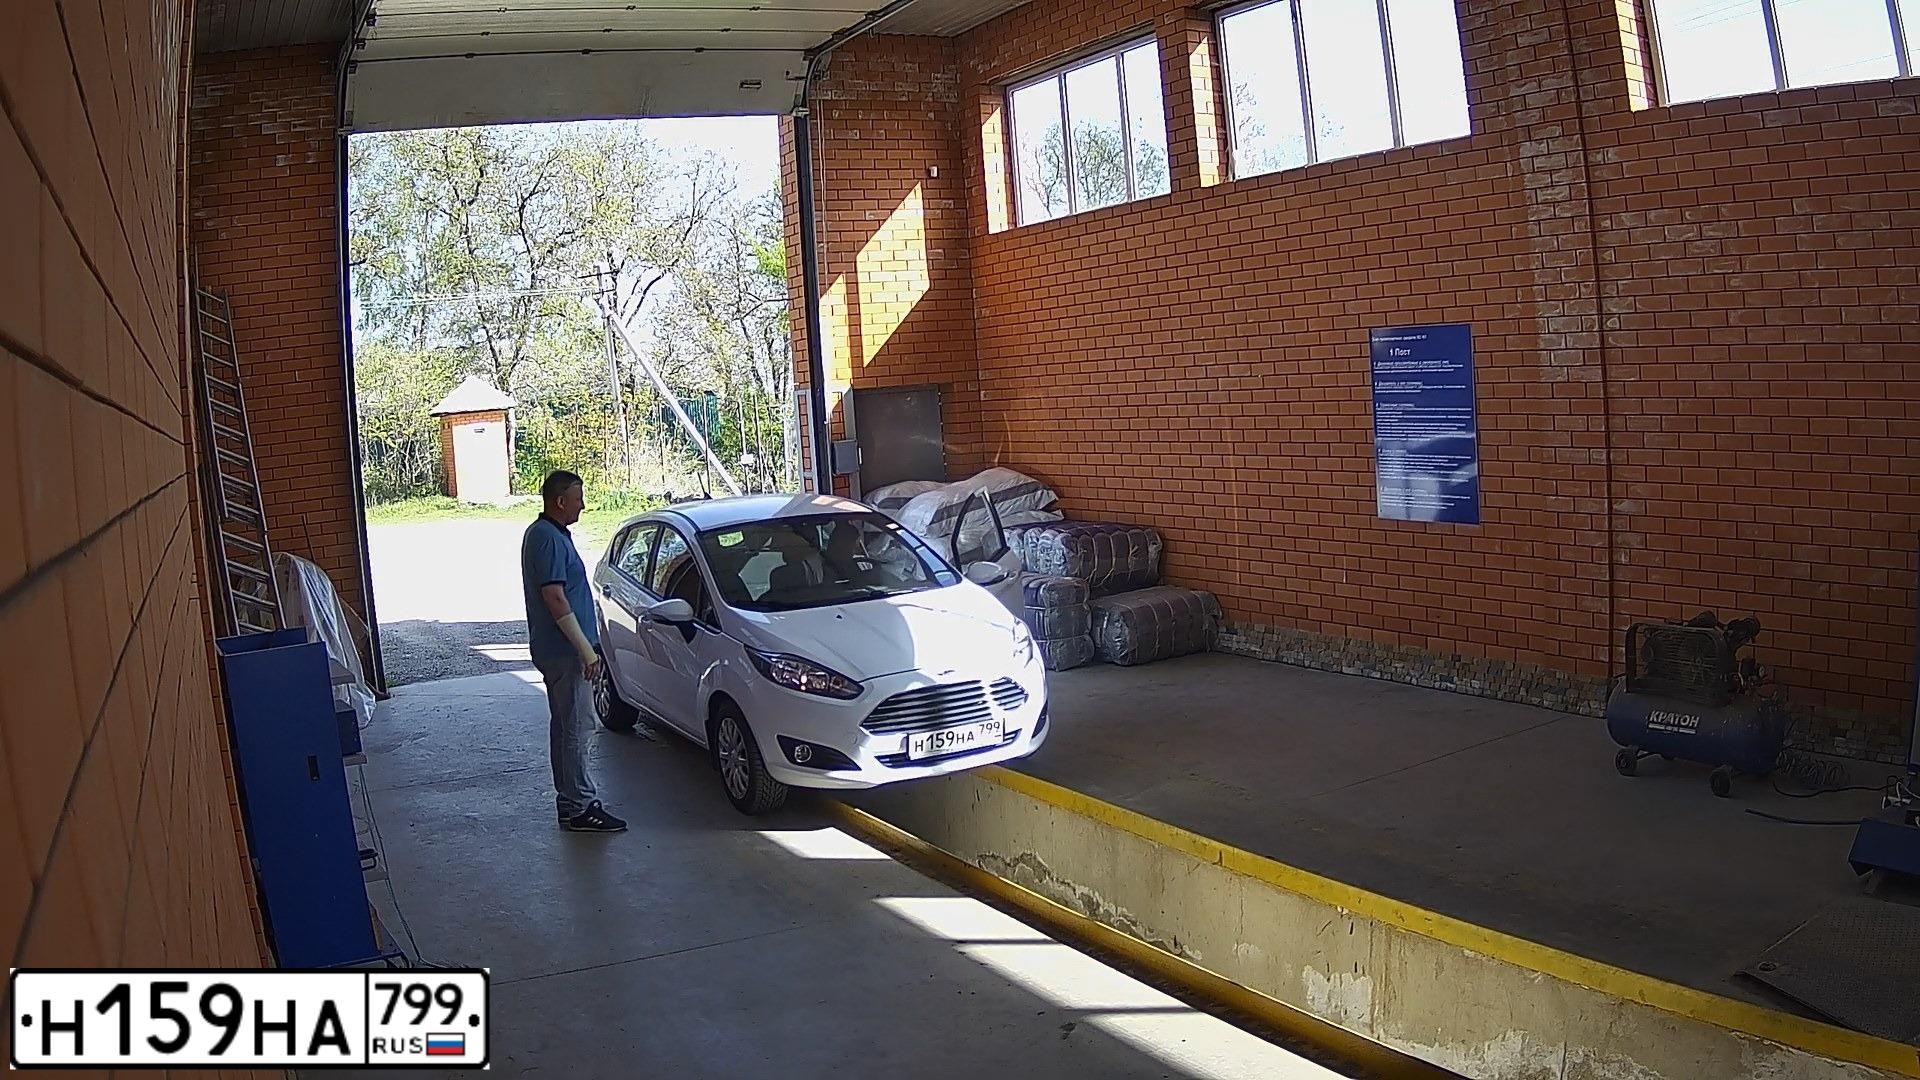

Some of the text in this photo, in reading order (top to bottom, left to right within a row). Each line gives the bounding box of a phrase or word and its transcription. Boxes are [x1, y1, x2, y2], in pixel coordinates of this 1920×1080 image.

[1394, 347, 1411, 356] Пост
[1648, 710, 1700, 728] КРАТОН
[914, 721, 1001, 752] Н159НА 799
